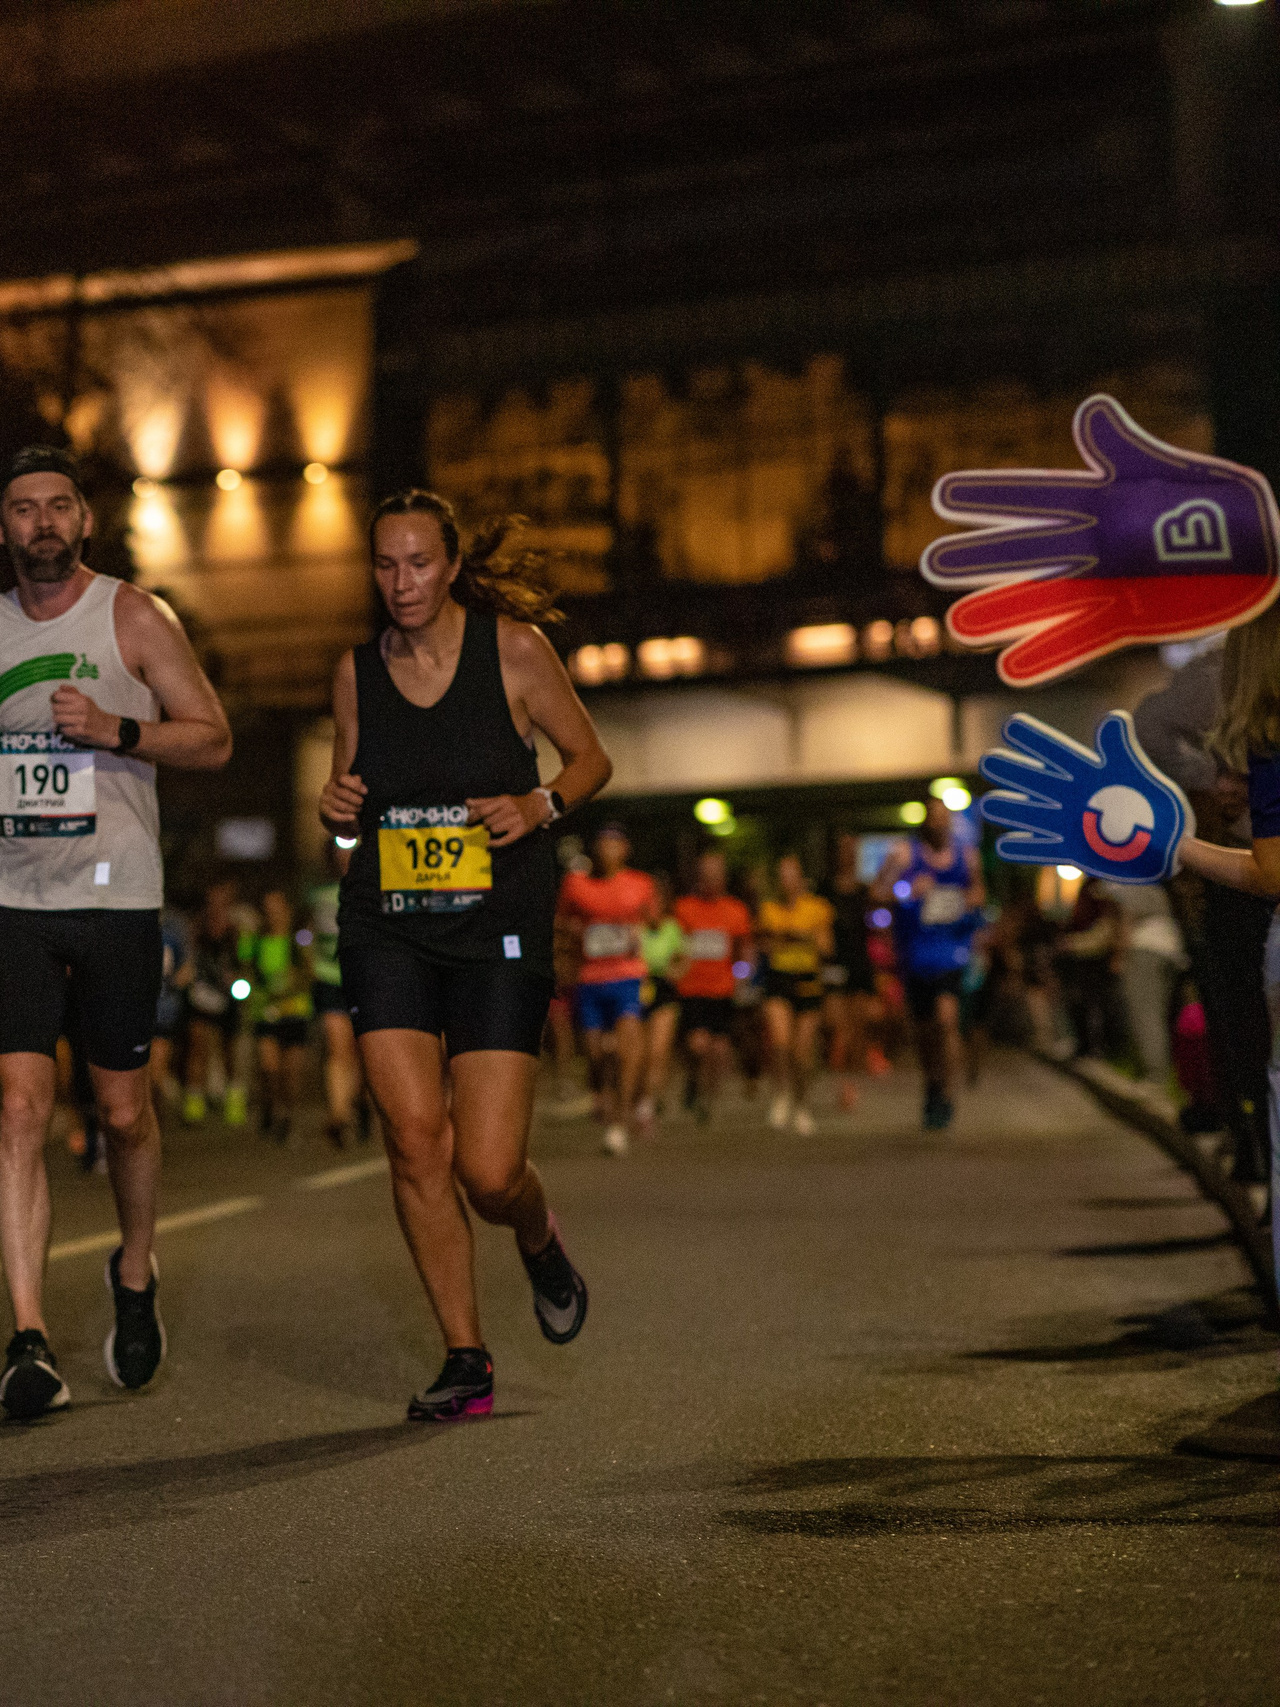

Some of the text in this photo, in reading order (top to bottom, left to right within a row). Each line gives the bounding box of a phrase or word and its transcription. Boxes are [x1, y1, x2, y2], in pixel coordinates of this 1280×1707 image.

[15, 762, 70, 796] 190
[406, 837, 465, 870] 189
[391, 892, 406, 913] D
